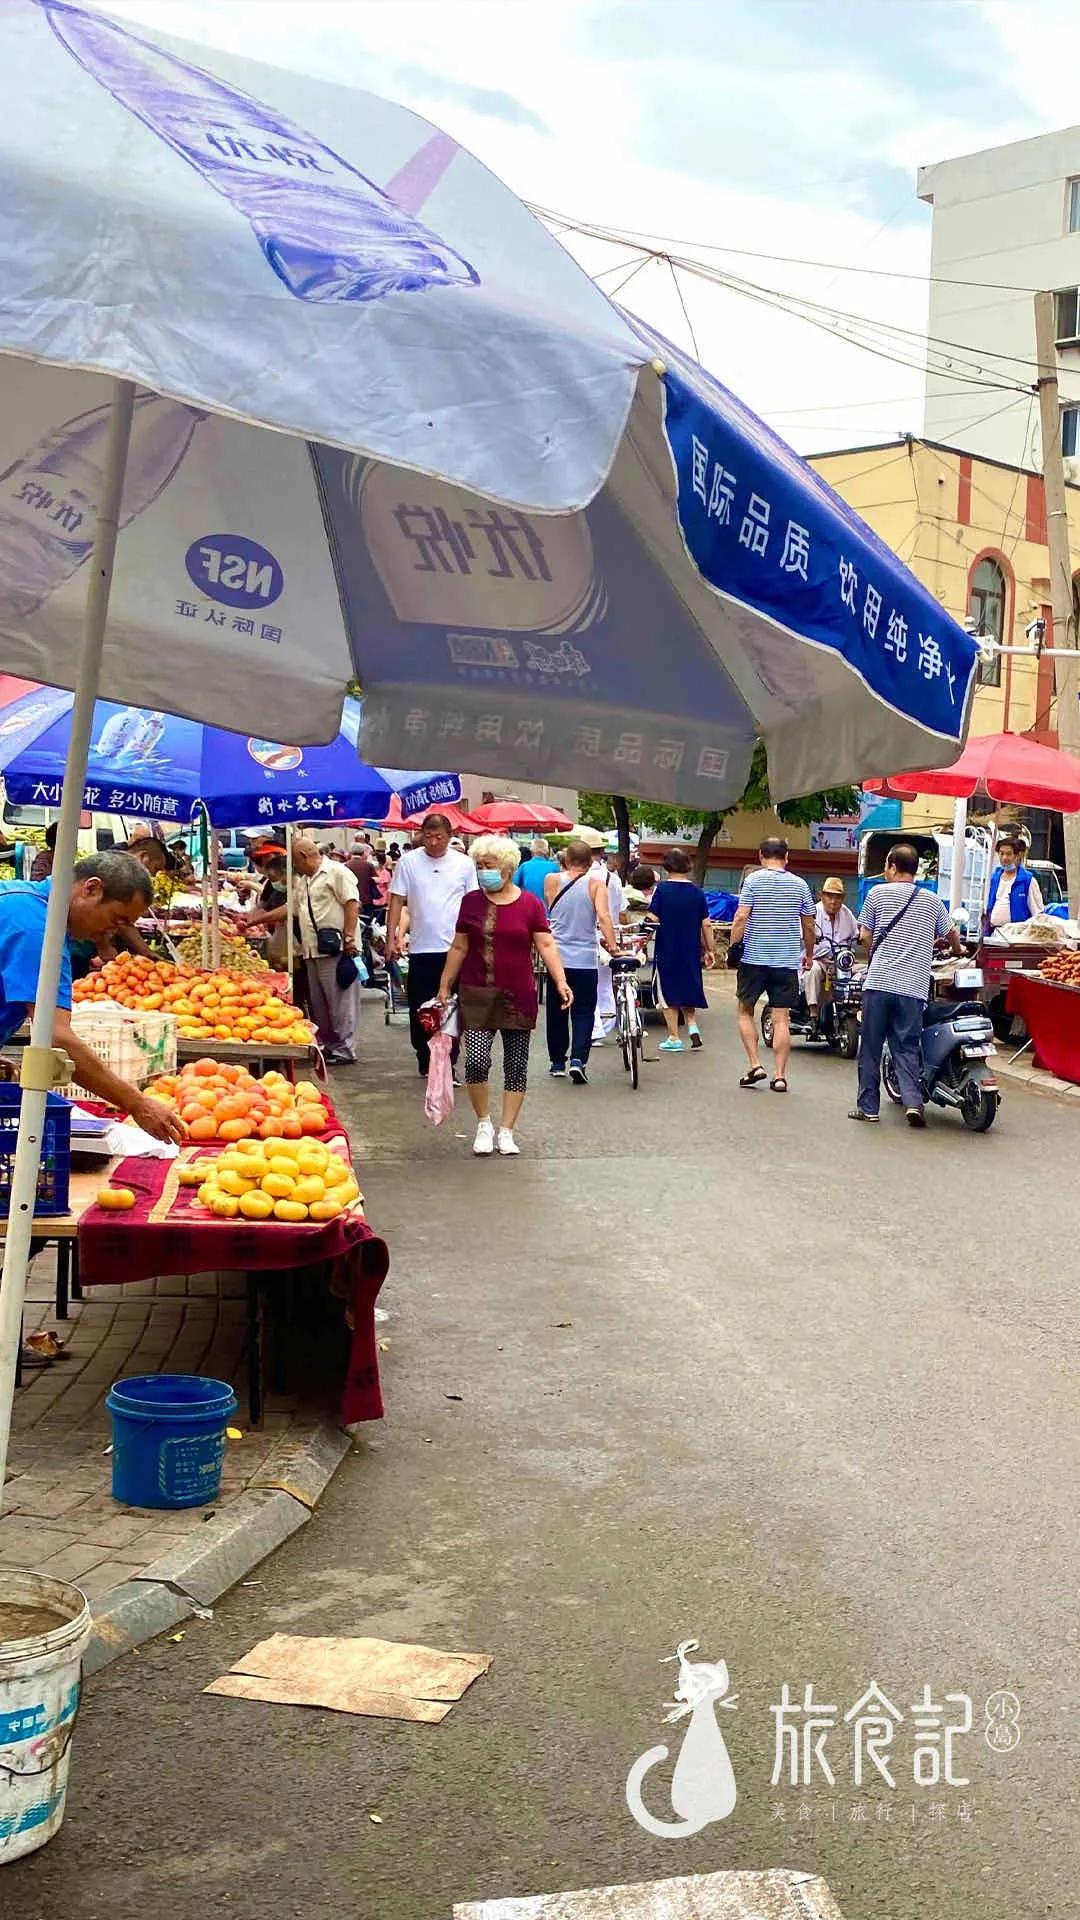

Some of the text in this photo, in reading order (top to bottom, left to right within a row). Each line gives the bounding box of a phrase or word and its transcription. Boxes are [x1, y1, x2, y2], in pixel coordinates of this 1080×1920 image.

[691, 434, 810, 582] 国际品质
[32, 781, 179, 816] 大小花 多少随意
